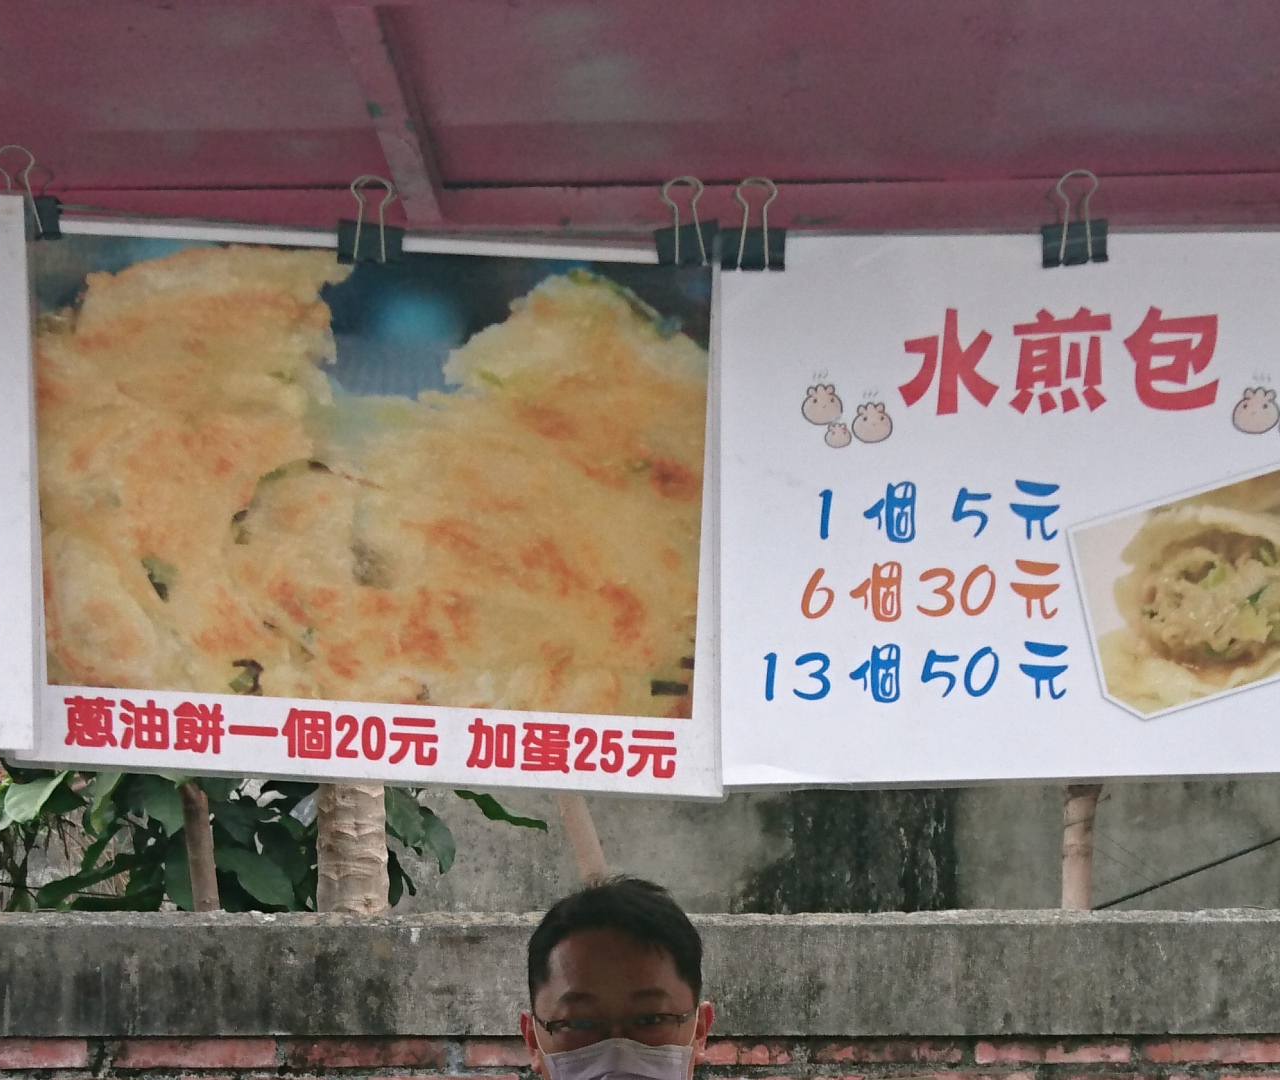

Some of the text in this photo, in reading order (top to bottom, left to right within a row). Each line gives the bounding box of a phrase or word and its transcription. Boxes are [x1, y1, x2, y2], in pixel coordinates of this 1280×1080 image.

[898, 306, 1220, 417] 水煎包
[65, 696, 678, 779] 蔥油餅一個20元 加蛋25元
